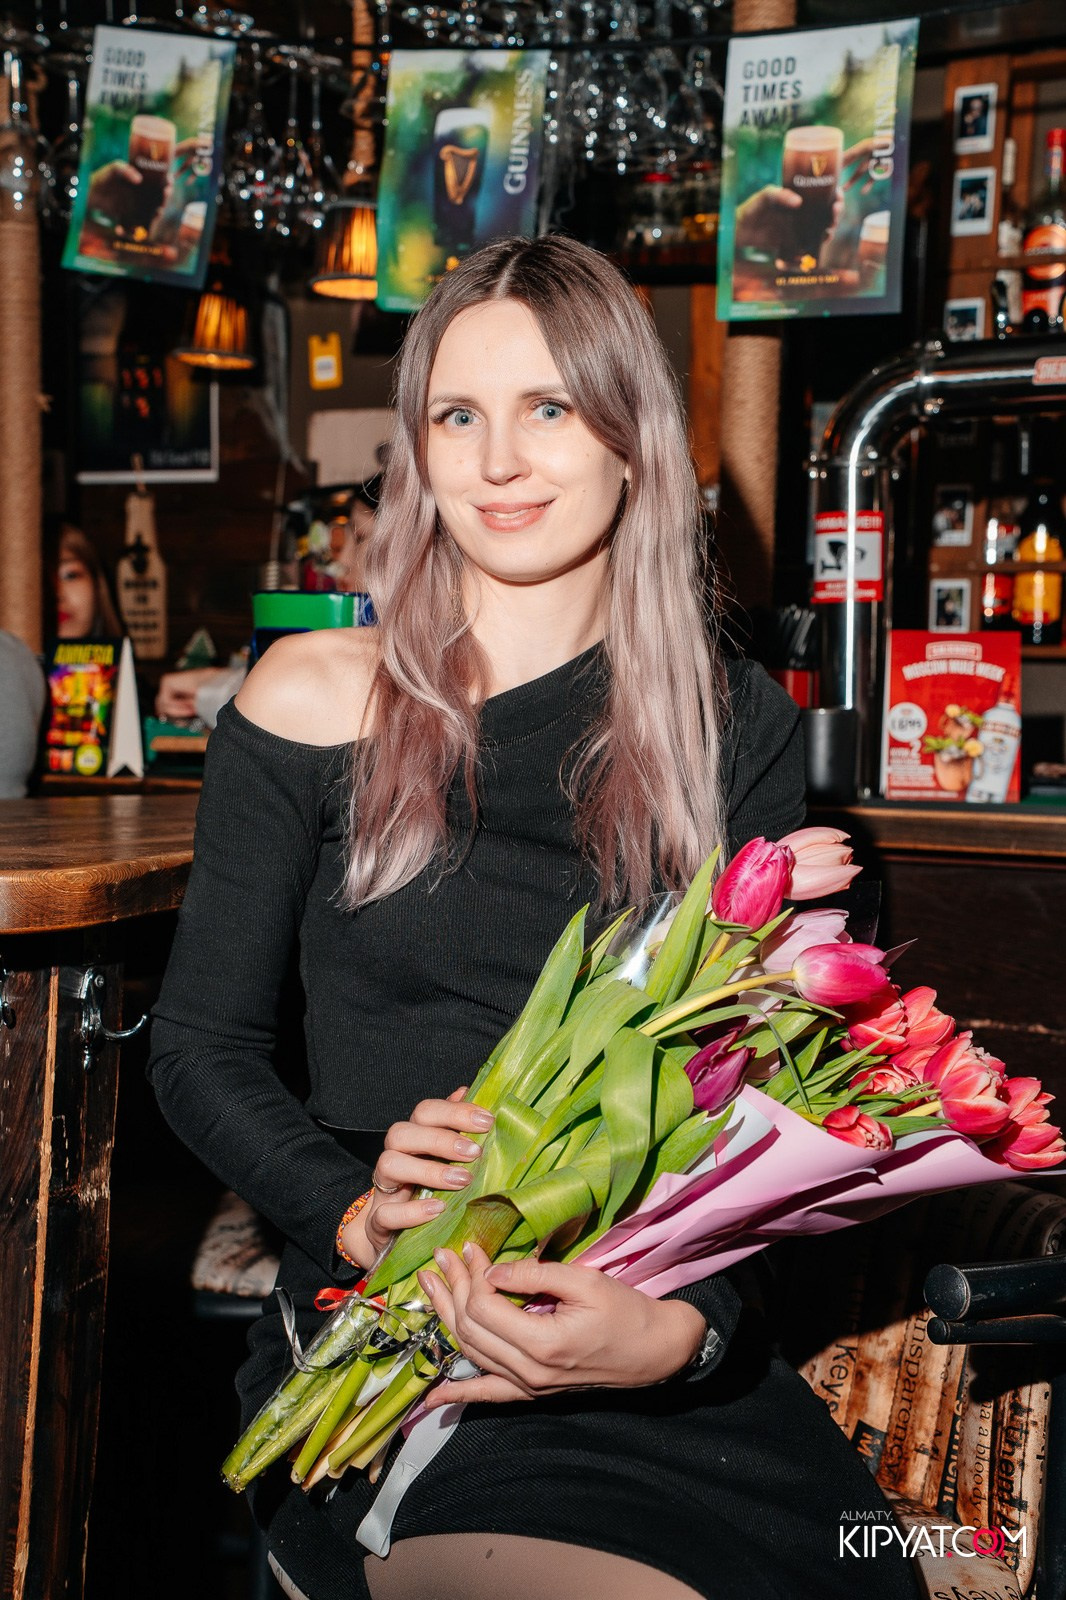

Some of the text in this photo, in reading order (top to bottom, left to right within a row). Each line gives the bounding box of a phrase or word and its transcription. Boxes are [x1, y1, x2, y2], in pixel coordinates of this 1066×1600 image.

[743, 56, 797, 80] GOOD
[742, 80, 803, 103] TIMES
[740, 103, 801, 127] AWAIT
[503, 67, 535, 195] GUINNESS
[971, 1444, 991, 1511] bloody
